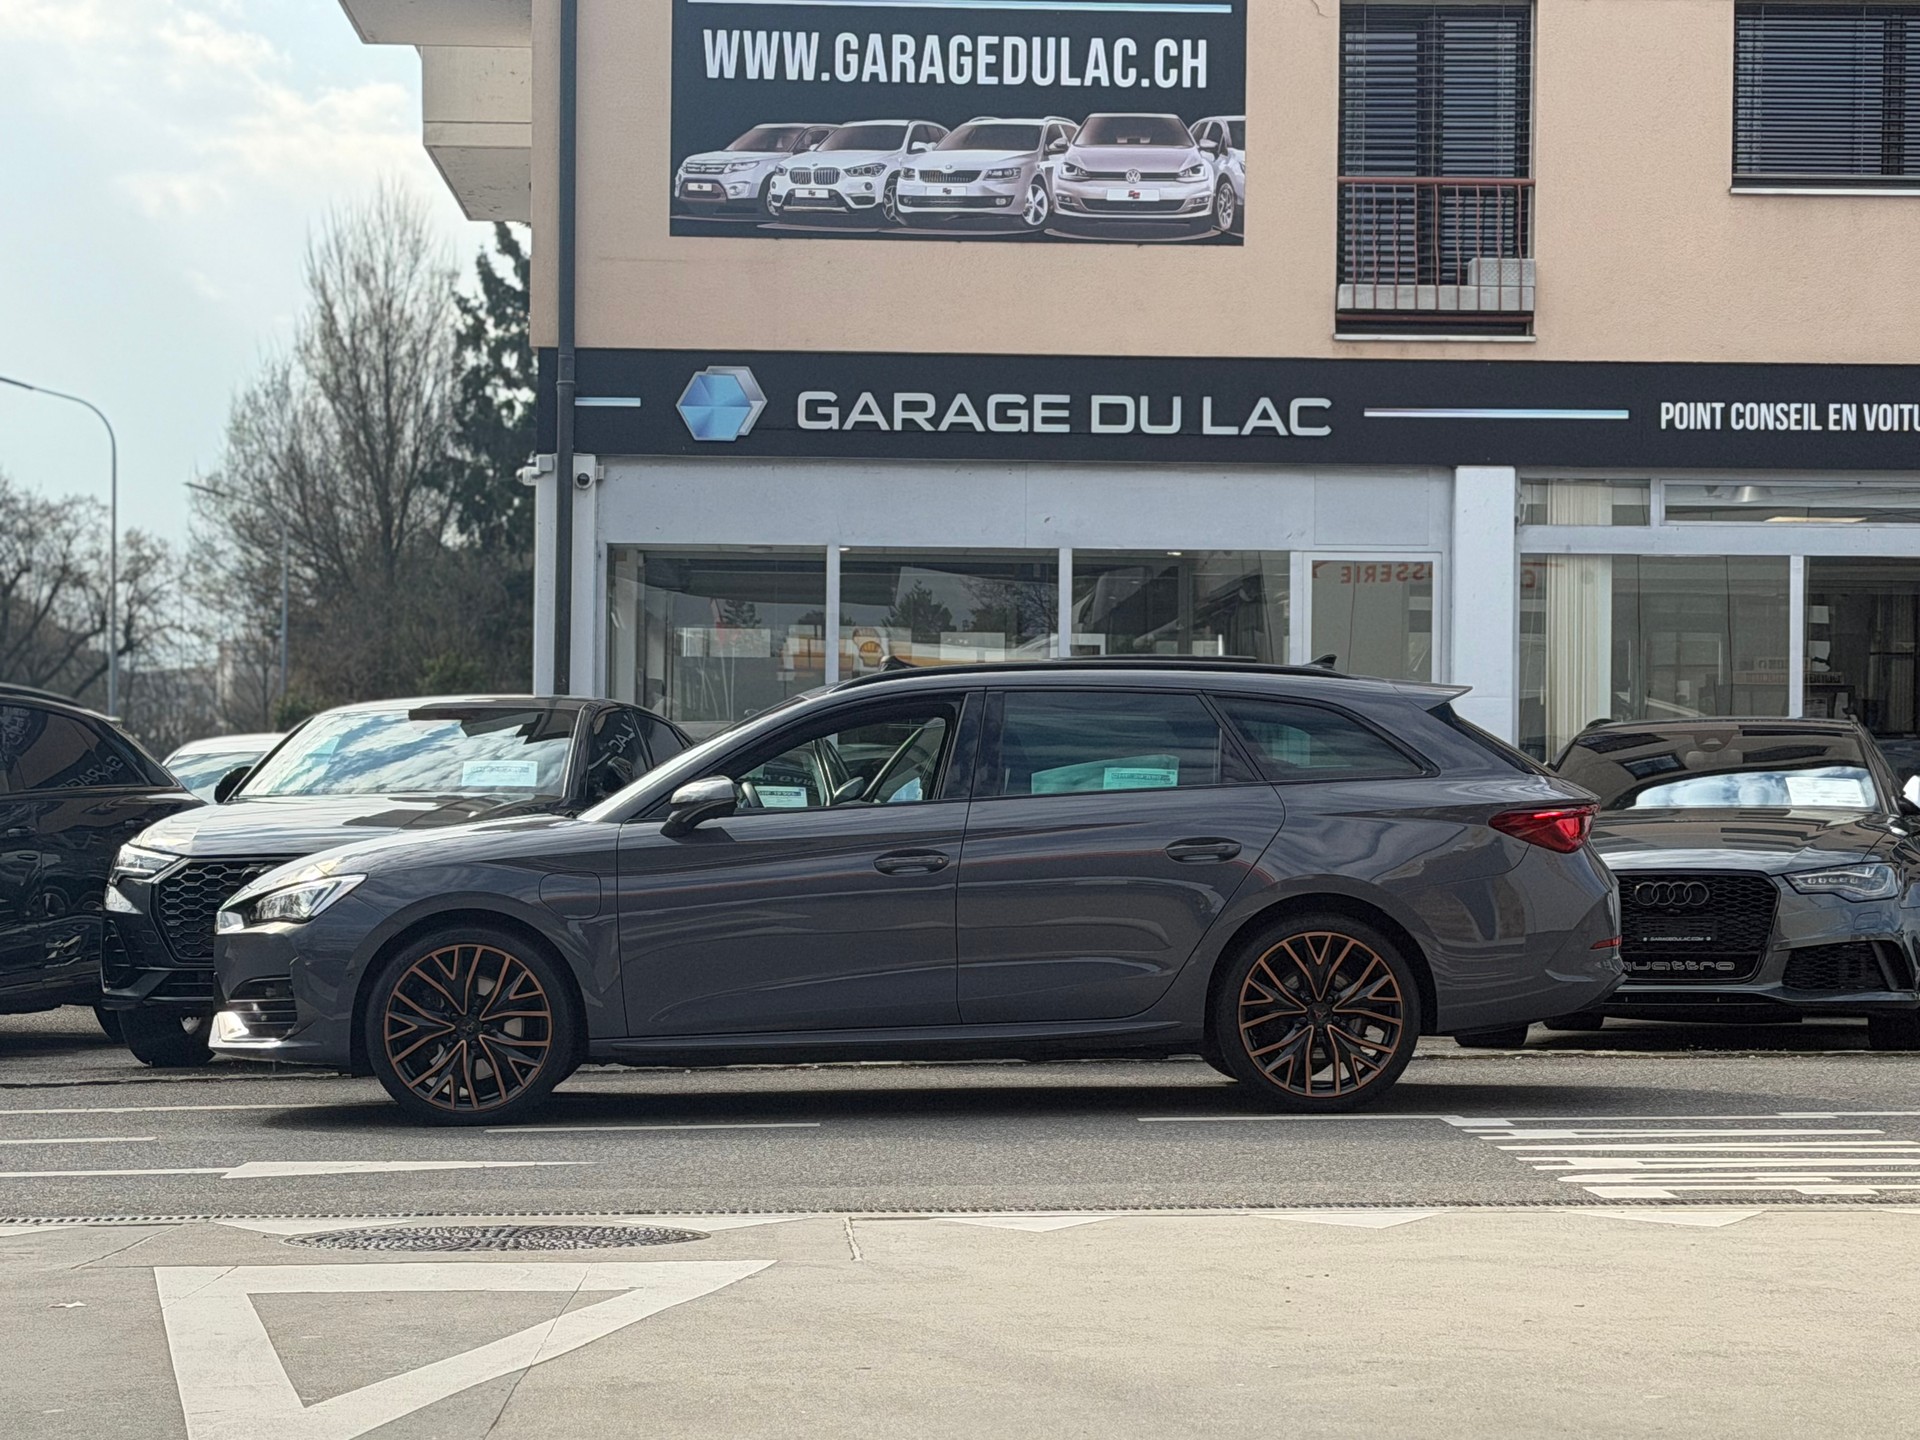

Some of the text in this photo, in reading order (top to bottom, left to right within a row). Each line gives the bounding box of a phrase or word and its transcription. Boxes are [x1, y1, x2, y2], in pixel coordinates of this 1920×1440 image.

[702, 28, 1208, 89] WWW.GARAGEDULAC.CH
[797, 390, 1332, 437] GARAGE DU LAC
[1660, 401, 1726, 431] POINT
[1730, 402, 1823, 432] CONSEIL
[1828, 403, 1857, 432] EN
